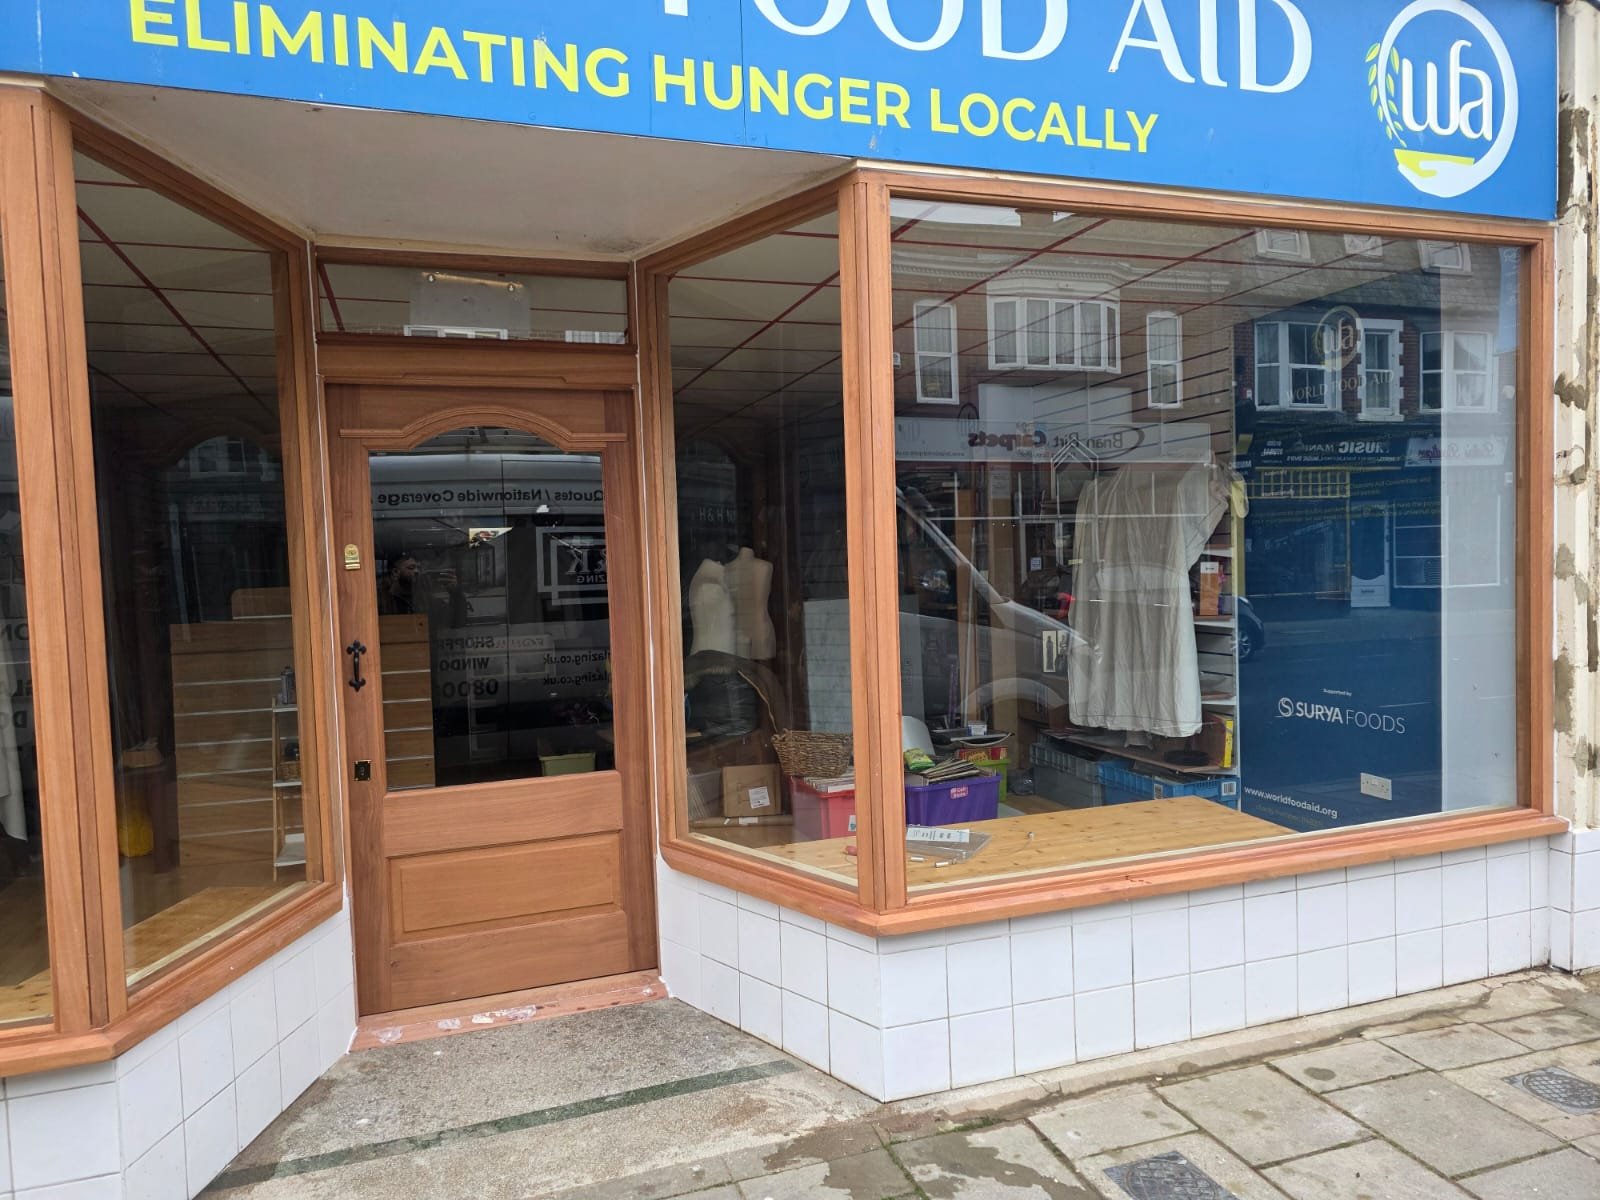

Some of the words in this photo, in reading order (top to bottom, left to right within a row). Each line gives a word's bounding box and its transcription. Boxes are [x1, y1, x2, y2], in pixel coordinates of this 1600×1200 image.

[130, 0, 630, 97] ELIMINATING
[654, 54, 911, 128] HUNGER
[930, 88, 1159, 153] LOCALLY
[1108, 0, 1312, 93] AID
[1295, 701, 1344, 724] SURYA
[1345, 709, 1406, 734] FOODS
[1243, 786, 1338, 819] www.worldfoodaid.org
